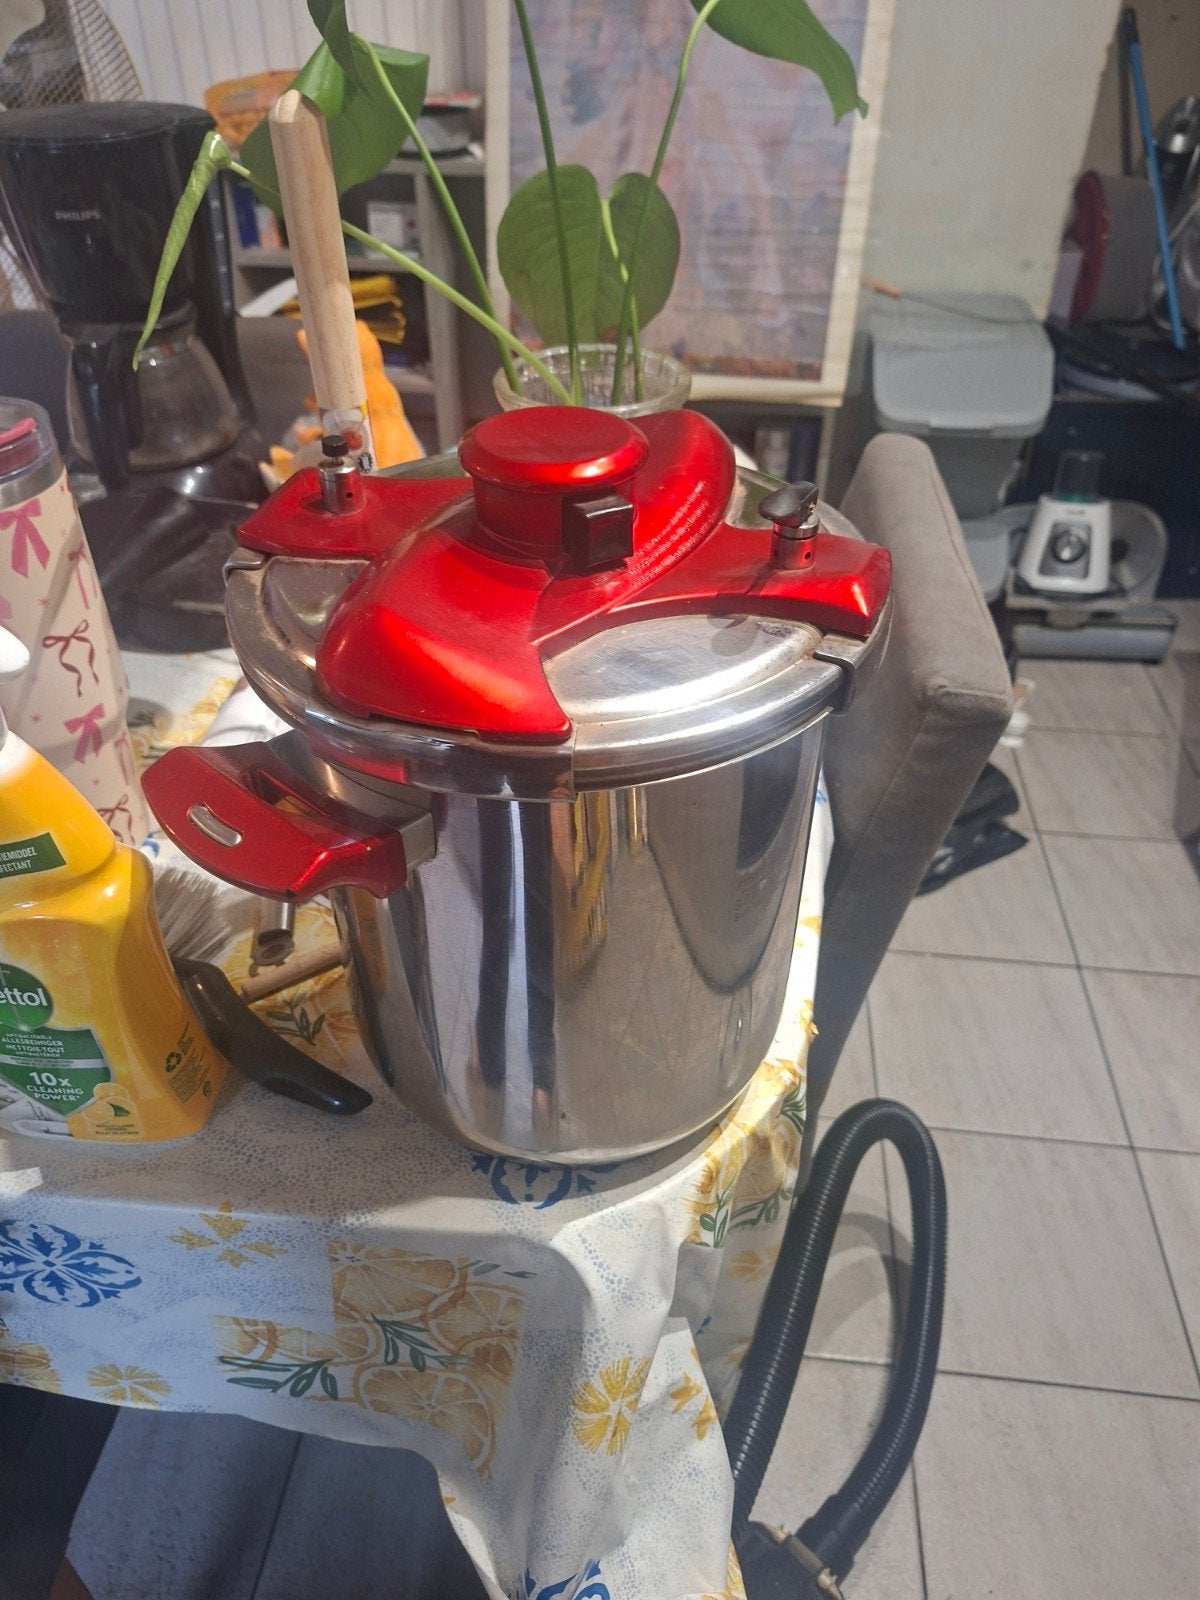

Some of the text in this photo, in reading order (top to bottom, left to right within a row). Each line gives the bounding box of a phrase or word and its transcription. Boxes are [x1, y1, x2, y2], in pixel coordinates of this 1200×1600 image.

[54, 209, 101, 221] PHILIPS
[0, 846, 38, 861] IEMIDDEL
[2, 1037, 64, 1047] ALLESREINIGER
[26, 1085, 84, 1095] CLEANING
